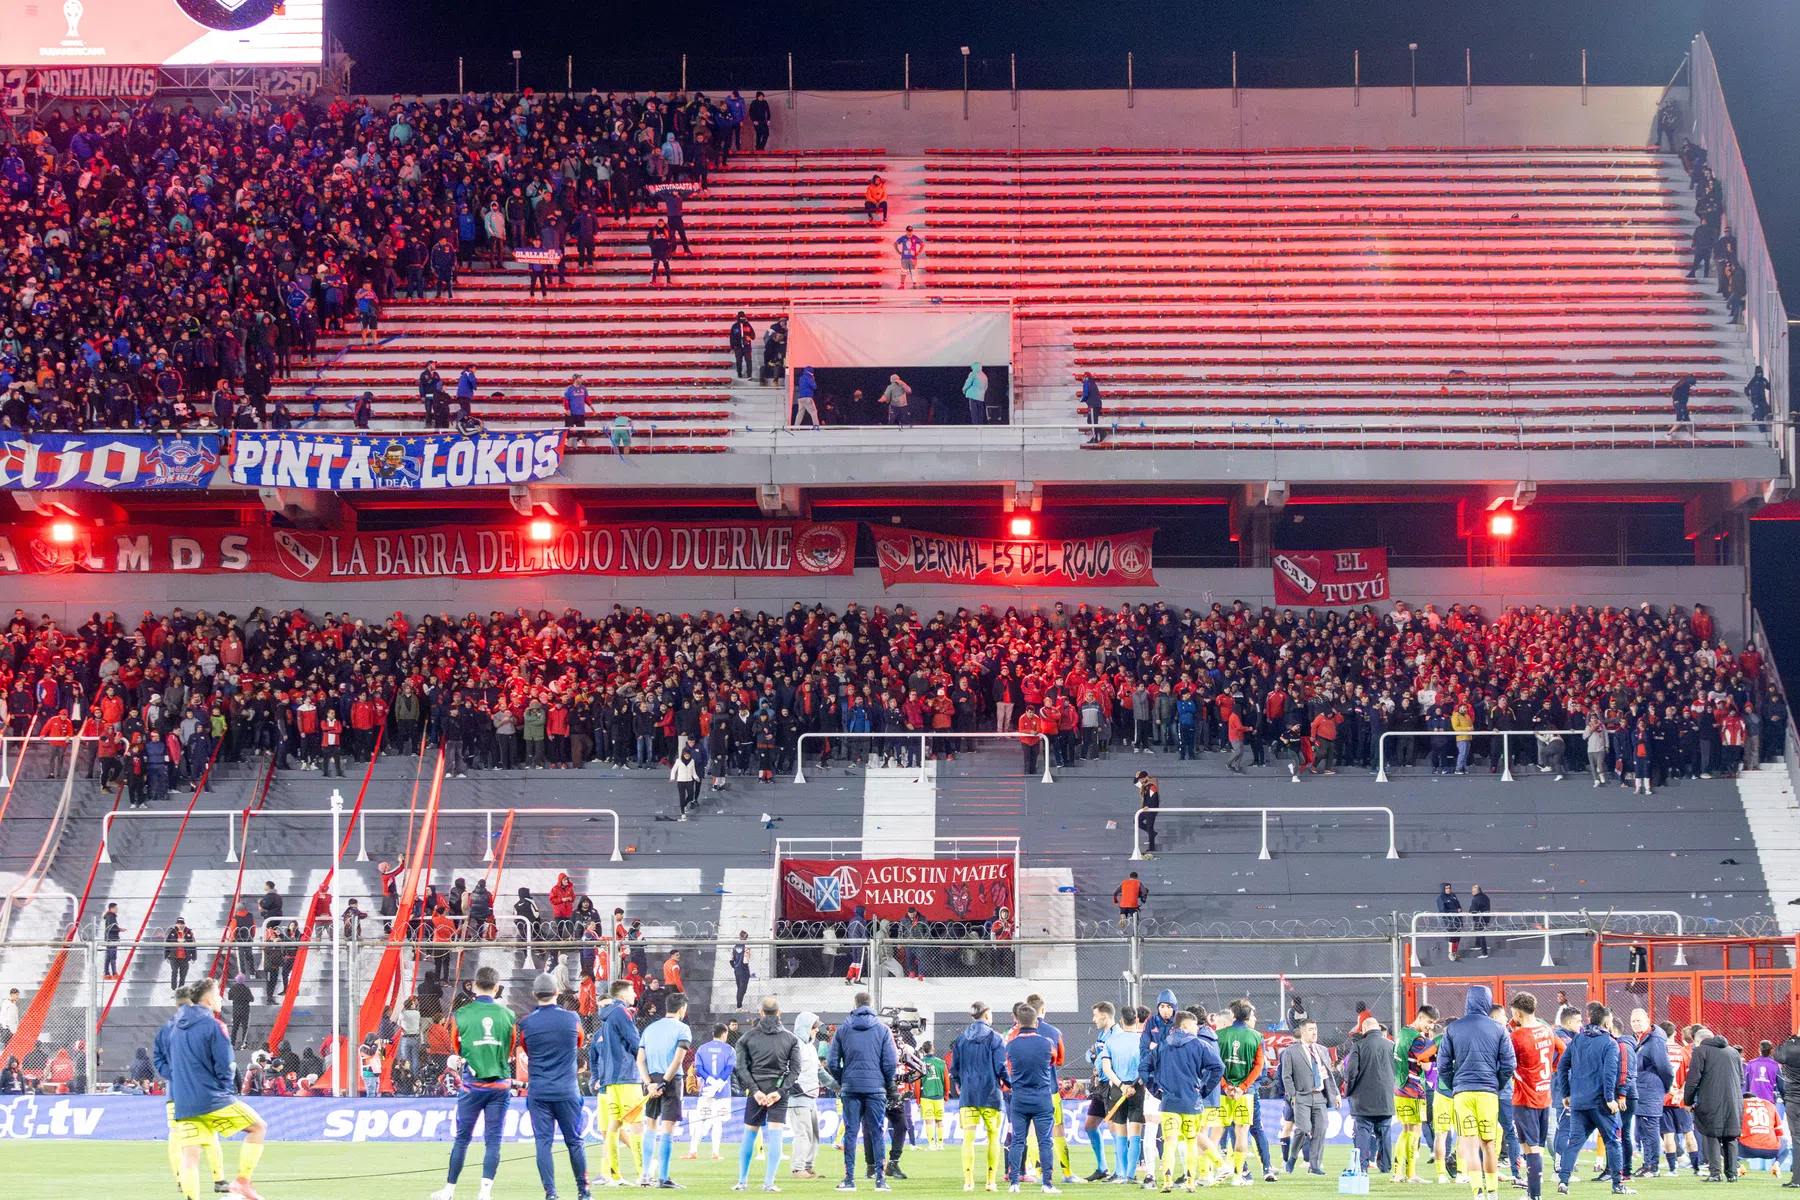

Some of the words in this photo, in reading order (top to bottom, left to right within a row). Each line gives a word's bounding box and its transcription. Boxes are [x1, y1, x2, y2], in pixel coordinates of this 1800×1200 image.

[37, 66, 155, 97] MONTANIAKOS
[270, 70, 318, 98] 250
[232, 440, 374, 489] PINTA
[420, 435, 560, 488] LOKOS
[328, 535, 370, 576] LA
[373, 530, 472, 575] BARRA
[476, 530, 535, 573] DEL
[619, 526, 664, 571] NO
[669, 526, 793, 570] DUERME
[910, 535, 988, 579] BERNAL
[992, 541, 1016, 577] ES
[1020, 541, 1057, 575] DEL
[1062, 539, 1112, 581] ROJO
[1335, 552, 1368, 572] EL
[1321, 572, 1386, 602] TUYÚ
[864, 866, 948, 884] AGUSTIN
[864, 888, 936, 905] MARCOS
[1539, 1047, 1551, 1080] 5
[1745, 1106, 1770, 1127] 36
